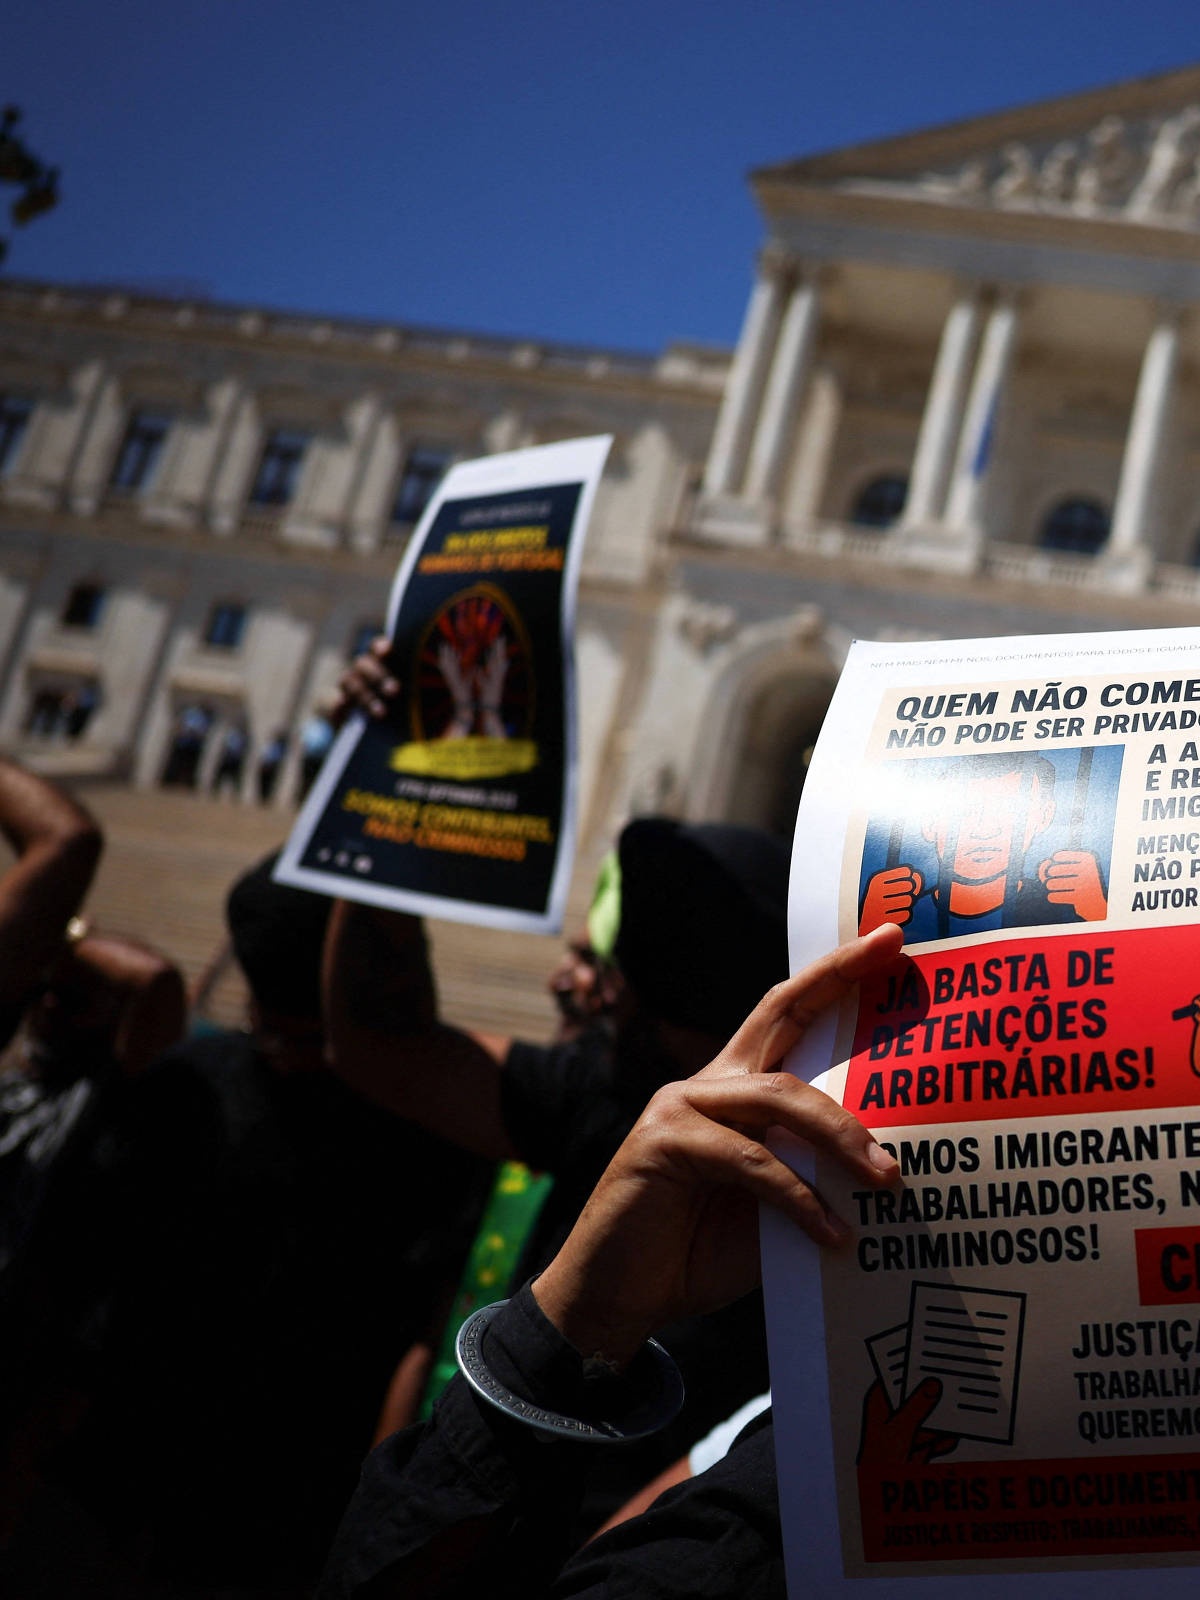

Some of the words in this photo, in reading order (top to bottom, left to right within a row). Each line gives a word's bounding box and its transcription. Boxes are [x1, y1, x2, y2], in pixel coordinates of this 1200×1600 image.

[995, 650, 1074, 662] DOCUMENTOS
[896, 691, 999, 723] QUEM
[1010, 681, 1088, 713] NÃO
[886, 722, 946, 749] NÃO
[953, 720, 1028, 745] PODE
[1034, 716, 1085, 739] SER
[1147, 744, 1167, 764] A
[1145, 770, 1162, 791] E
[1133, 857, 1183, 883] NÃO
[875, 965, 920, 1014] JÁ
[933, 953, 1050, 1005] BASTA
[1067, 947, 1115, 988] DE
[868, 995, 1108, 1061] DETENÇÕES
[859, 1047, 1156, 1111] ARBITRÁRIAS!
[879, 1137, 980, 1177] MOS
[852, 1172, 1166, 1226] TRABALHADORES,
[857, 1223, 1100, 1272] CRIMINOSOS!
[881, 1466, 990, 1513] PAPÉIS
[998, 1476, 1017, 1509] E
